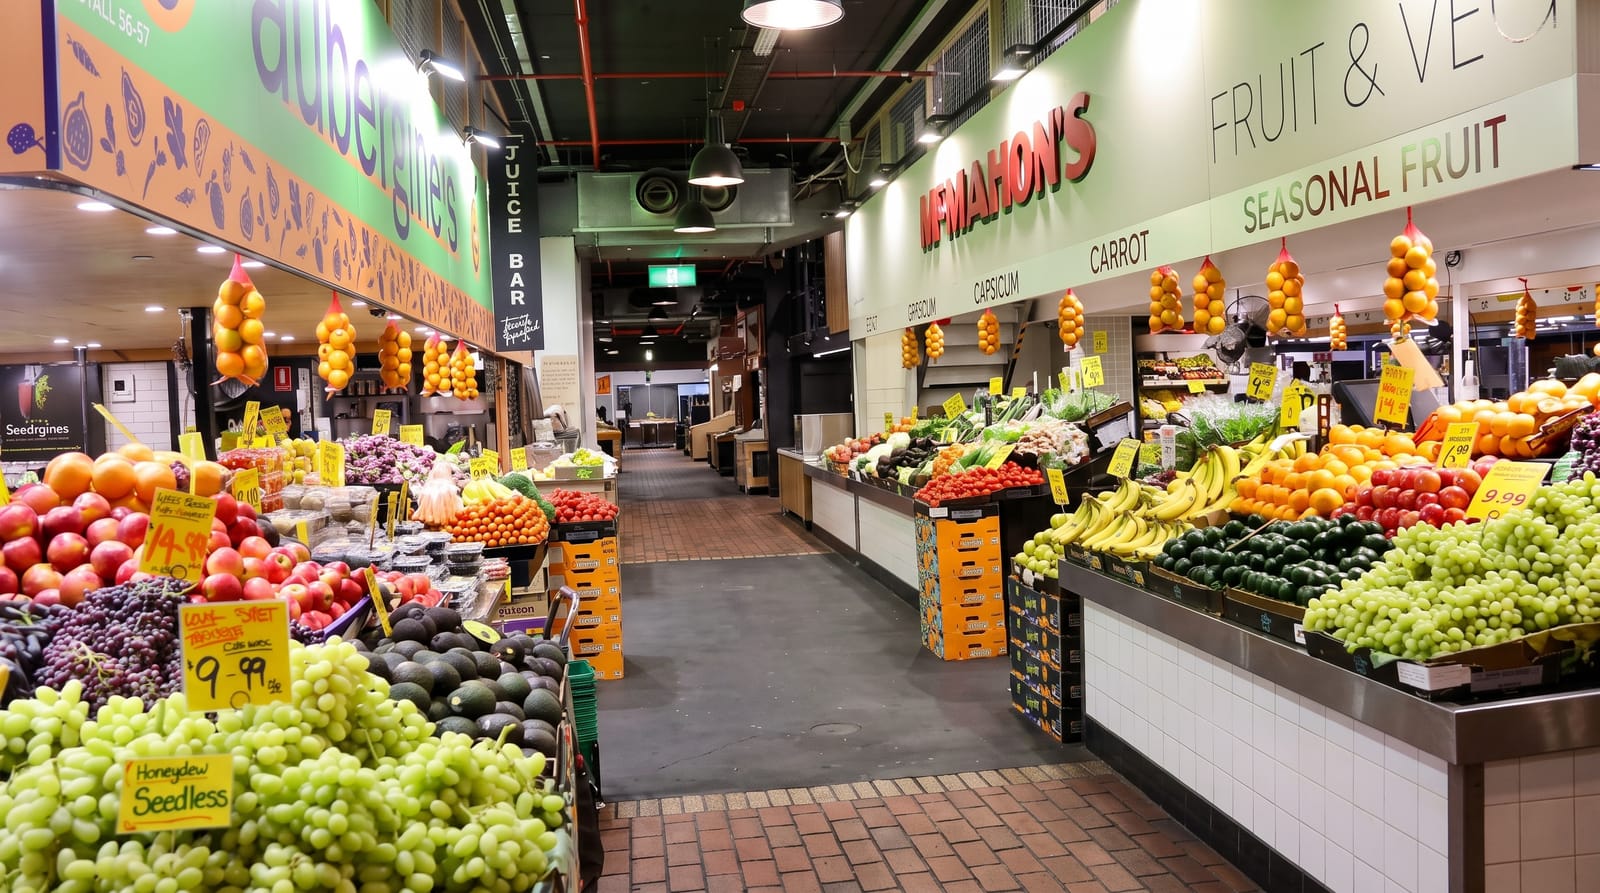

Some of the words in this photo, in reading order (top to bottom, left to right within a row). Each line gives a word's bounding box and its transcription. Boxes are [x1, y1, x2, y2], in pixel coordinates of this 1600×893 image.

[118, 7, 151, 48] 56-57
[1211, 41, 1325, 165] FRUIT
[1344, 22, 1386, 108] &
[504, 145, 523, 234] JUICE
[1243, 155, 1391, 234] SEASONAL
[1400, 113, 1507, 193] FRUIT
[1089, 229, 1150, 275] CARROT
[508, 253, 526, 306] BAR
[973, 270, 1020, 305] CAPSICUM
[5, 423, 70, 438] Seedrgines
[1481, 489, 1527, 506] 9.99
[136, 760, 209, 785] Honeydew
[132, 784, 229, 817] Seedless
